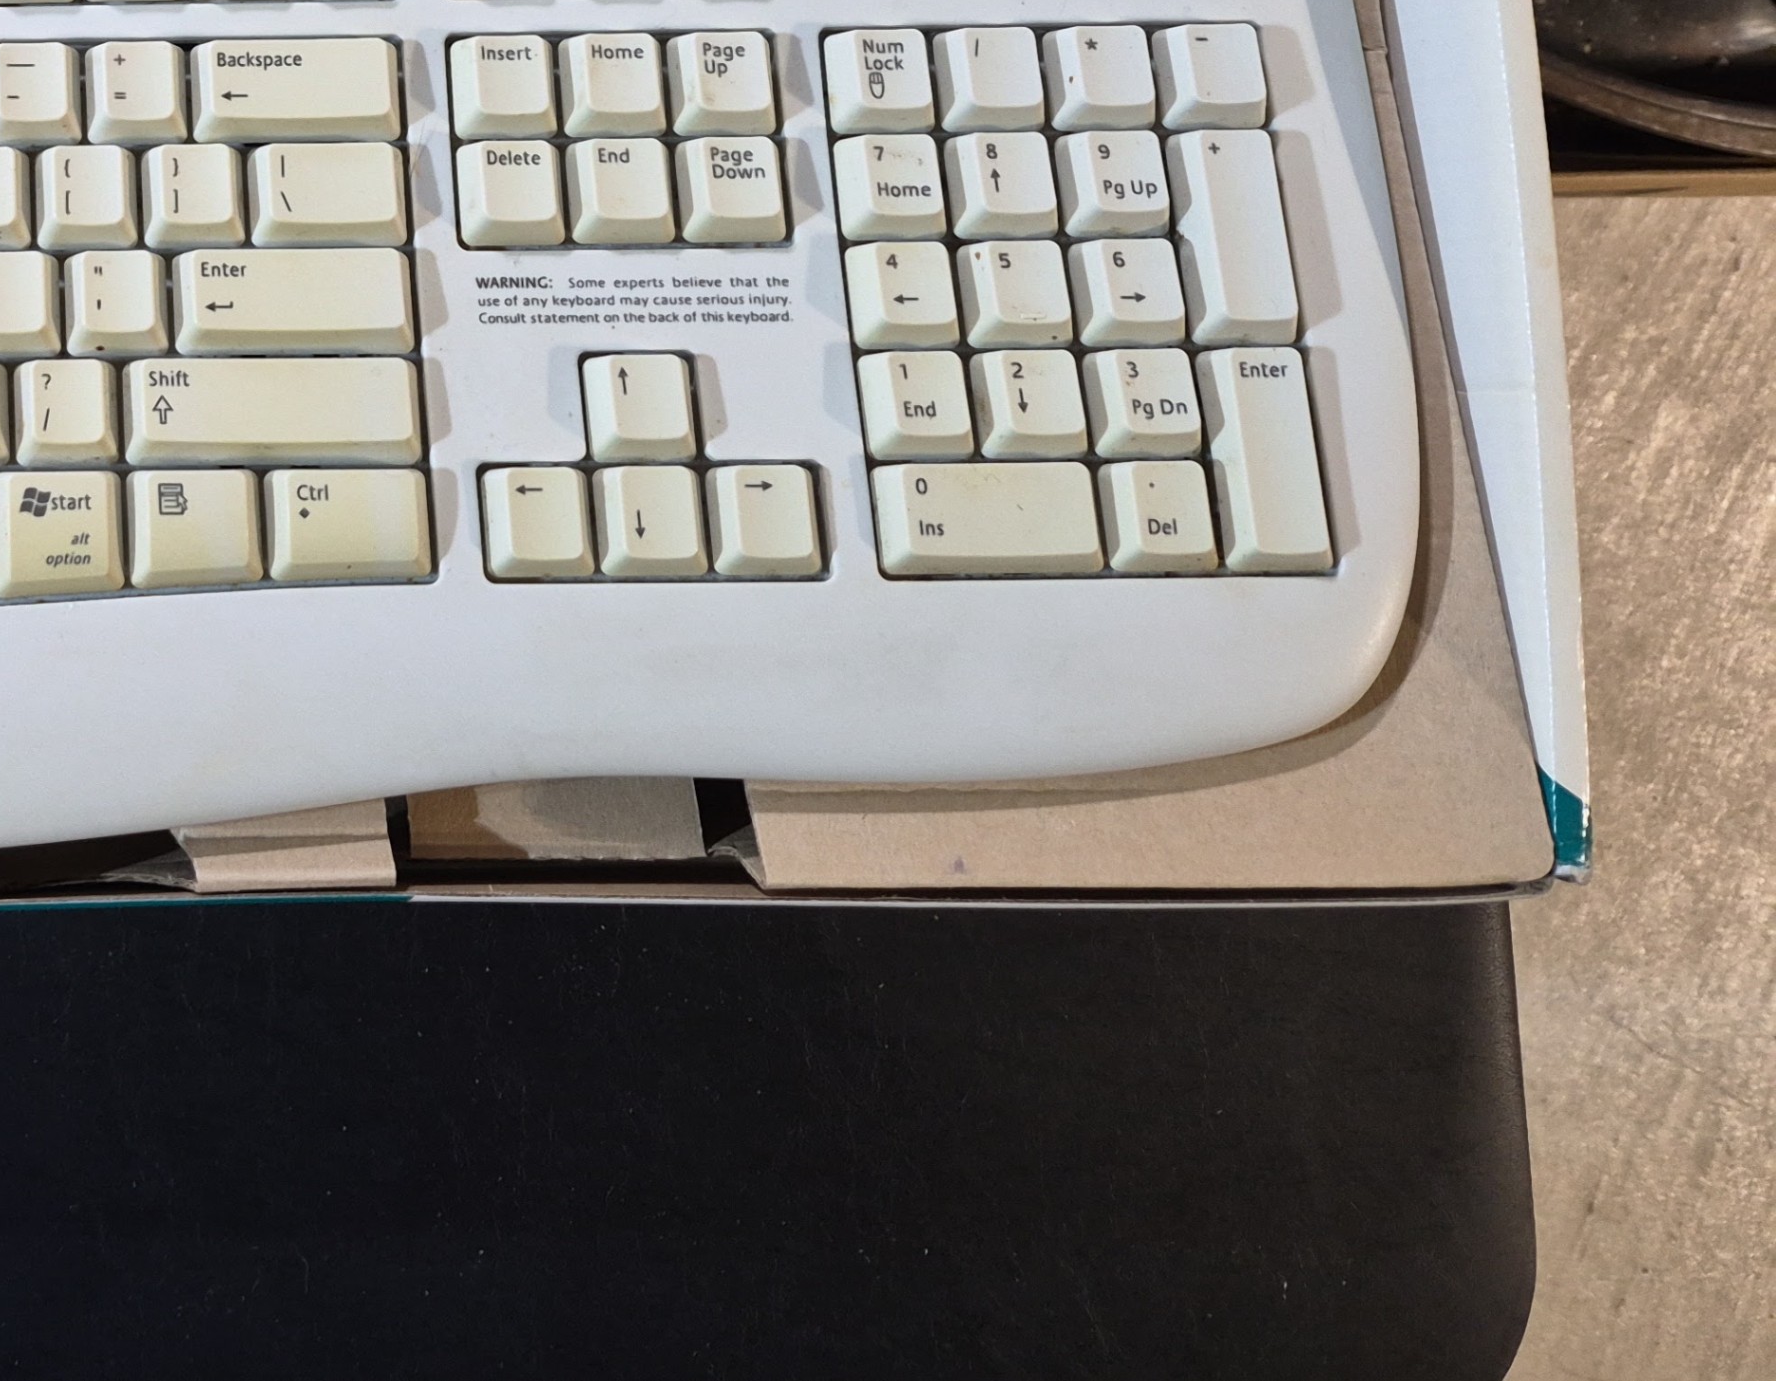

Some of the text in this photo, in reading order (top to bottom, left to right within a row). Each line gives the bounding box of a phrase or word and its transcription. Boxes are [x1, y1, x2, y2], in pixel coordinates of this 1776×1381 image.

[480, 45, 532, 61] Insert
[590, 44, 644, 60] Home
[702, 41, 746, 63] Page
[862, 38, 905, 54] Num
[216, 51, 303, 71] Backspace
[703, 59, 728, 78] Up
[863, 55, 905, 72] Lock
[486, 149, 541, 166] Delete
[597, 147, 630, 164] End
[709, 146, 754, 166] Page
[711, 163, 766, 180] Down
[876, 181, 932, 198] Home
[1102, 179, 1158, 200] Pg Up
[200, 261, 247, 278] Enter
[475, 275, 790, 291] WARNING: Some experts believe that the
[477, 293, 794, 309] use of any keyboard may cause serious injury.
[478, 310, 794, 325] Consult statement on the back of this keyboard.
[1238, 361, 1288, 379] Enter
[148, 370, 190, 388] Shift
[903, 400, 937, 419] End
[1131, 398, 1188, 421] Pg Dn
[296, 484, 329, 502] Ctrl
[50, 494, 92, 511] start
[918, 519, 945, 537] Ins
[1147, 518, 1178, 536] Del
[70, 532, 91, 546] alt
[45, 552, 92, 569] option
